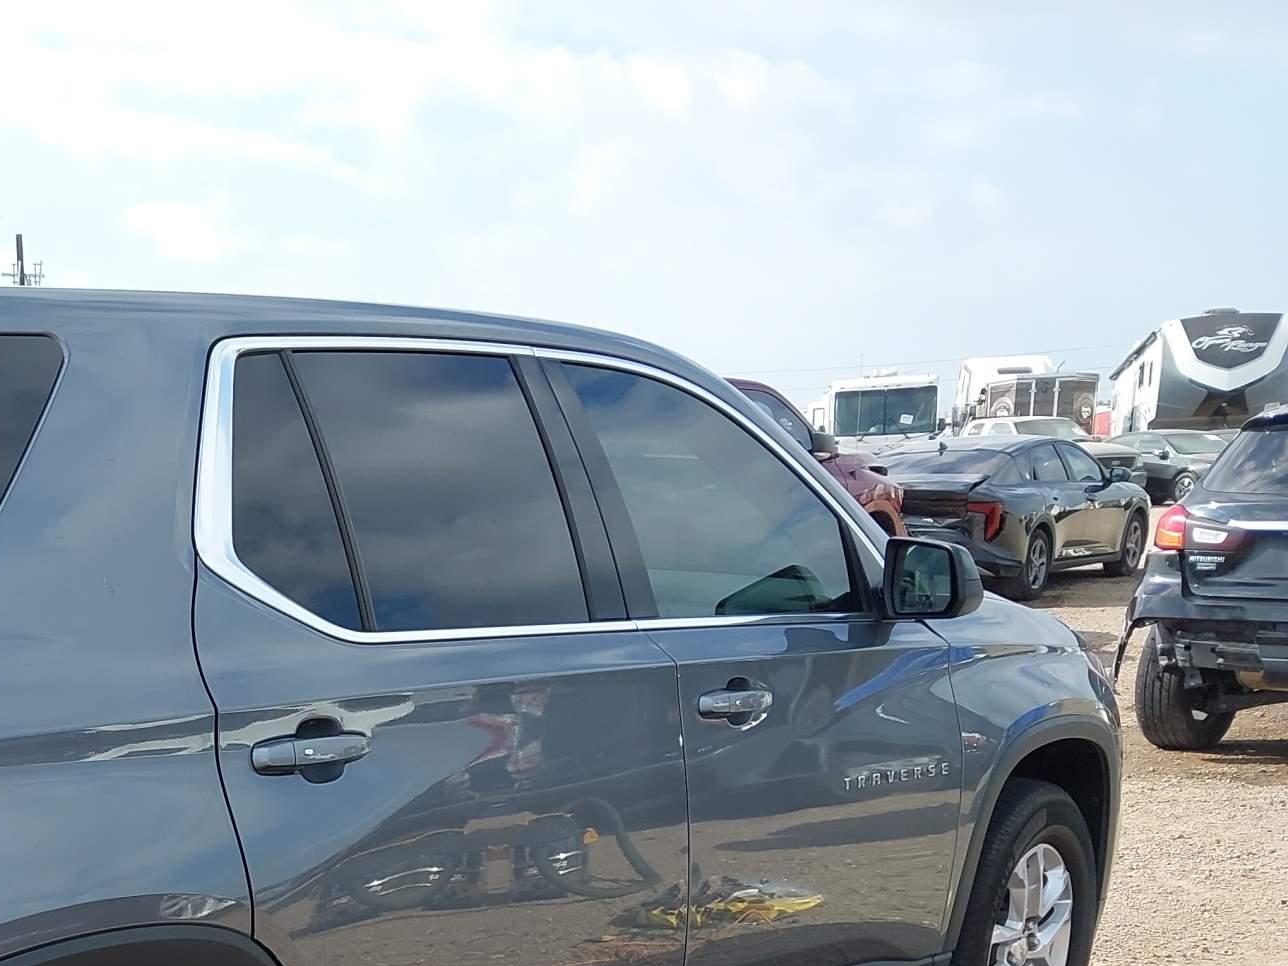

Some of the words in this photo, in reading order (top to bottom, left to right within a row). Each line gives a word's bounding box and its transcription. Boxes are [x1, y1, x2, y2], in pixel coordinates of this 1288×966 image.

[1220, 339, 1268, 353] Range
[1189, 555, 1225, 563] MITSUBISHI
[843, 762, 951, 791] TRAVERSE
